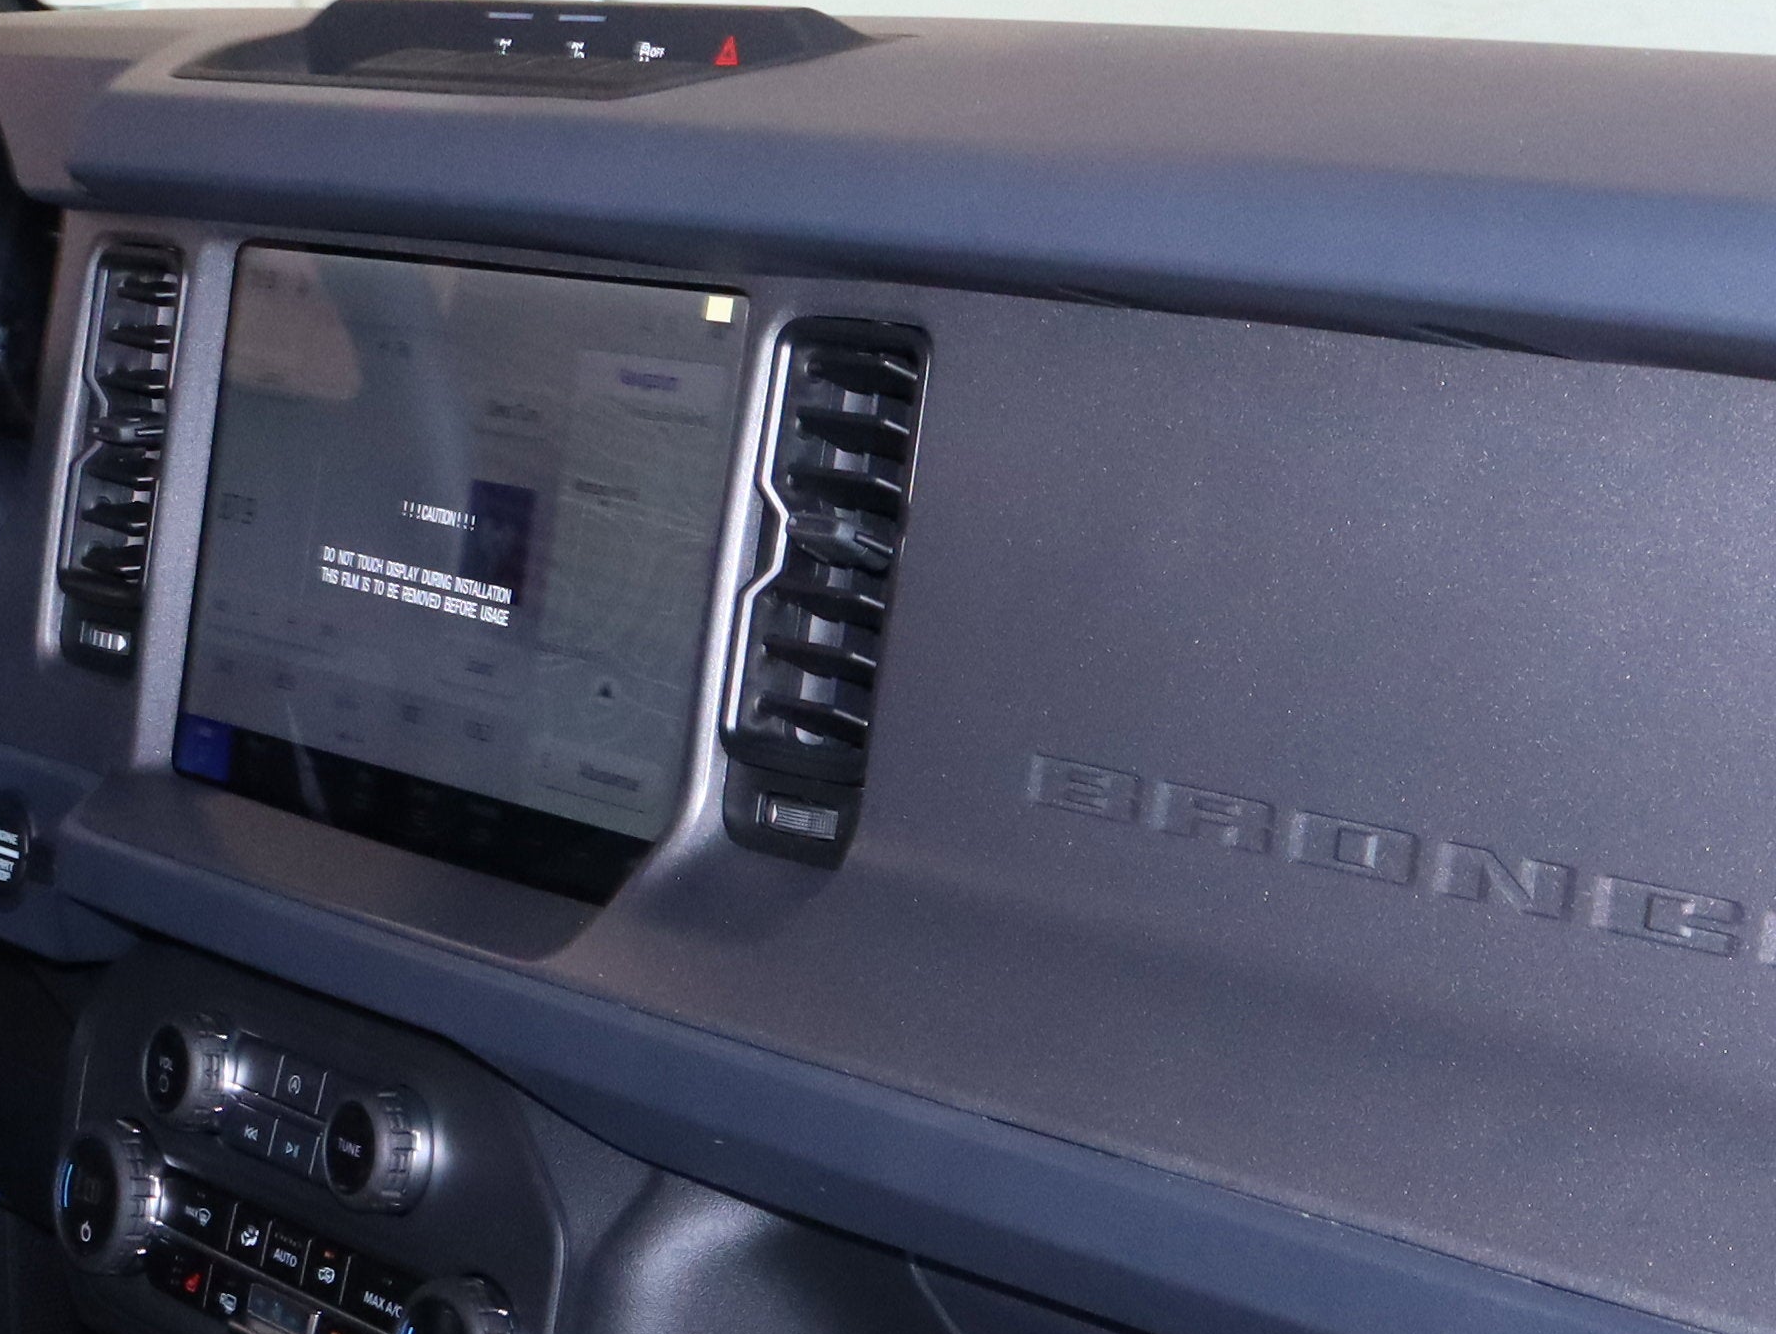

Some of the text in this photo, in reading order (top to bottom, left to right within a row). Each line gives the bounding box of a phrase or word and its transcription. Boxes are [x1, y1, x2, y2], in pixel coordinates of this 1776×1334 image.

[322, 545, 512, 605] DO NOT TOUCH DISPLAY DURING INSTALLATION
[321, 567, 510, 627] THIS FILM IS TO BE REMOVED BEFORE USAGE
[336, 1137, 364, 1159] TUNE
[272, 1247, 298, 1268] AUTO
[363, 1291, 403, 1319] MAX A/C
